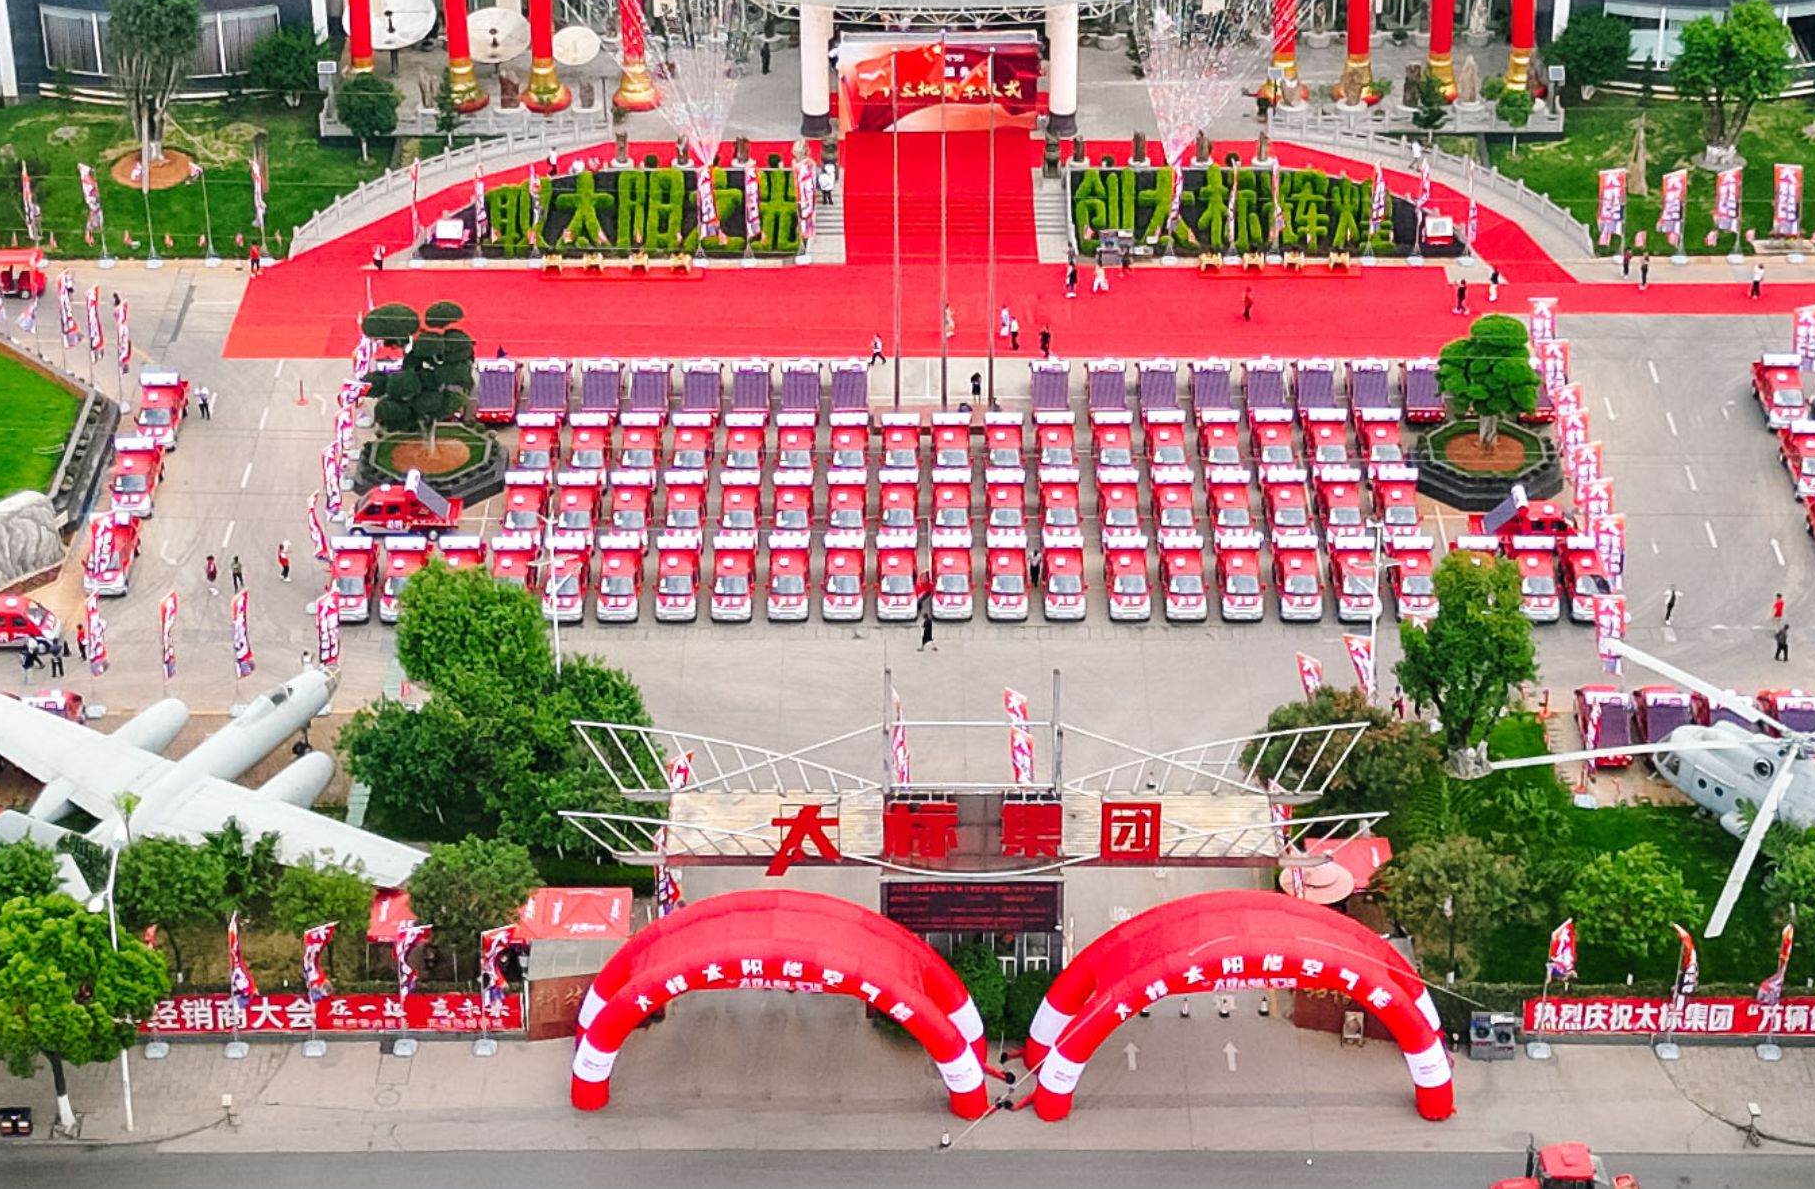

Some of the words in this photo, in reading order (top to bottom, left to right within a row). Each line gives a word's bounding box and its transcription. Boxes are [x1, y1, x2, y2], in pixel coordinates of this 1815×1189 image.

[765, 801, 1161, 877] 太标集团
[148, 996, 317, 1031] 经销商大会
[327, 997, 407, 1018] 在一起
[429, 997, 511, 1018] 赢未来
